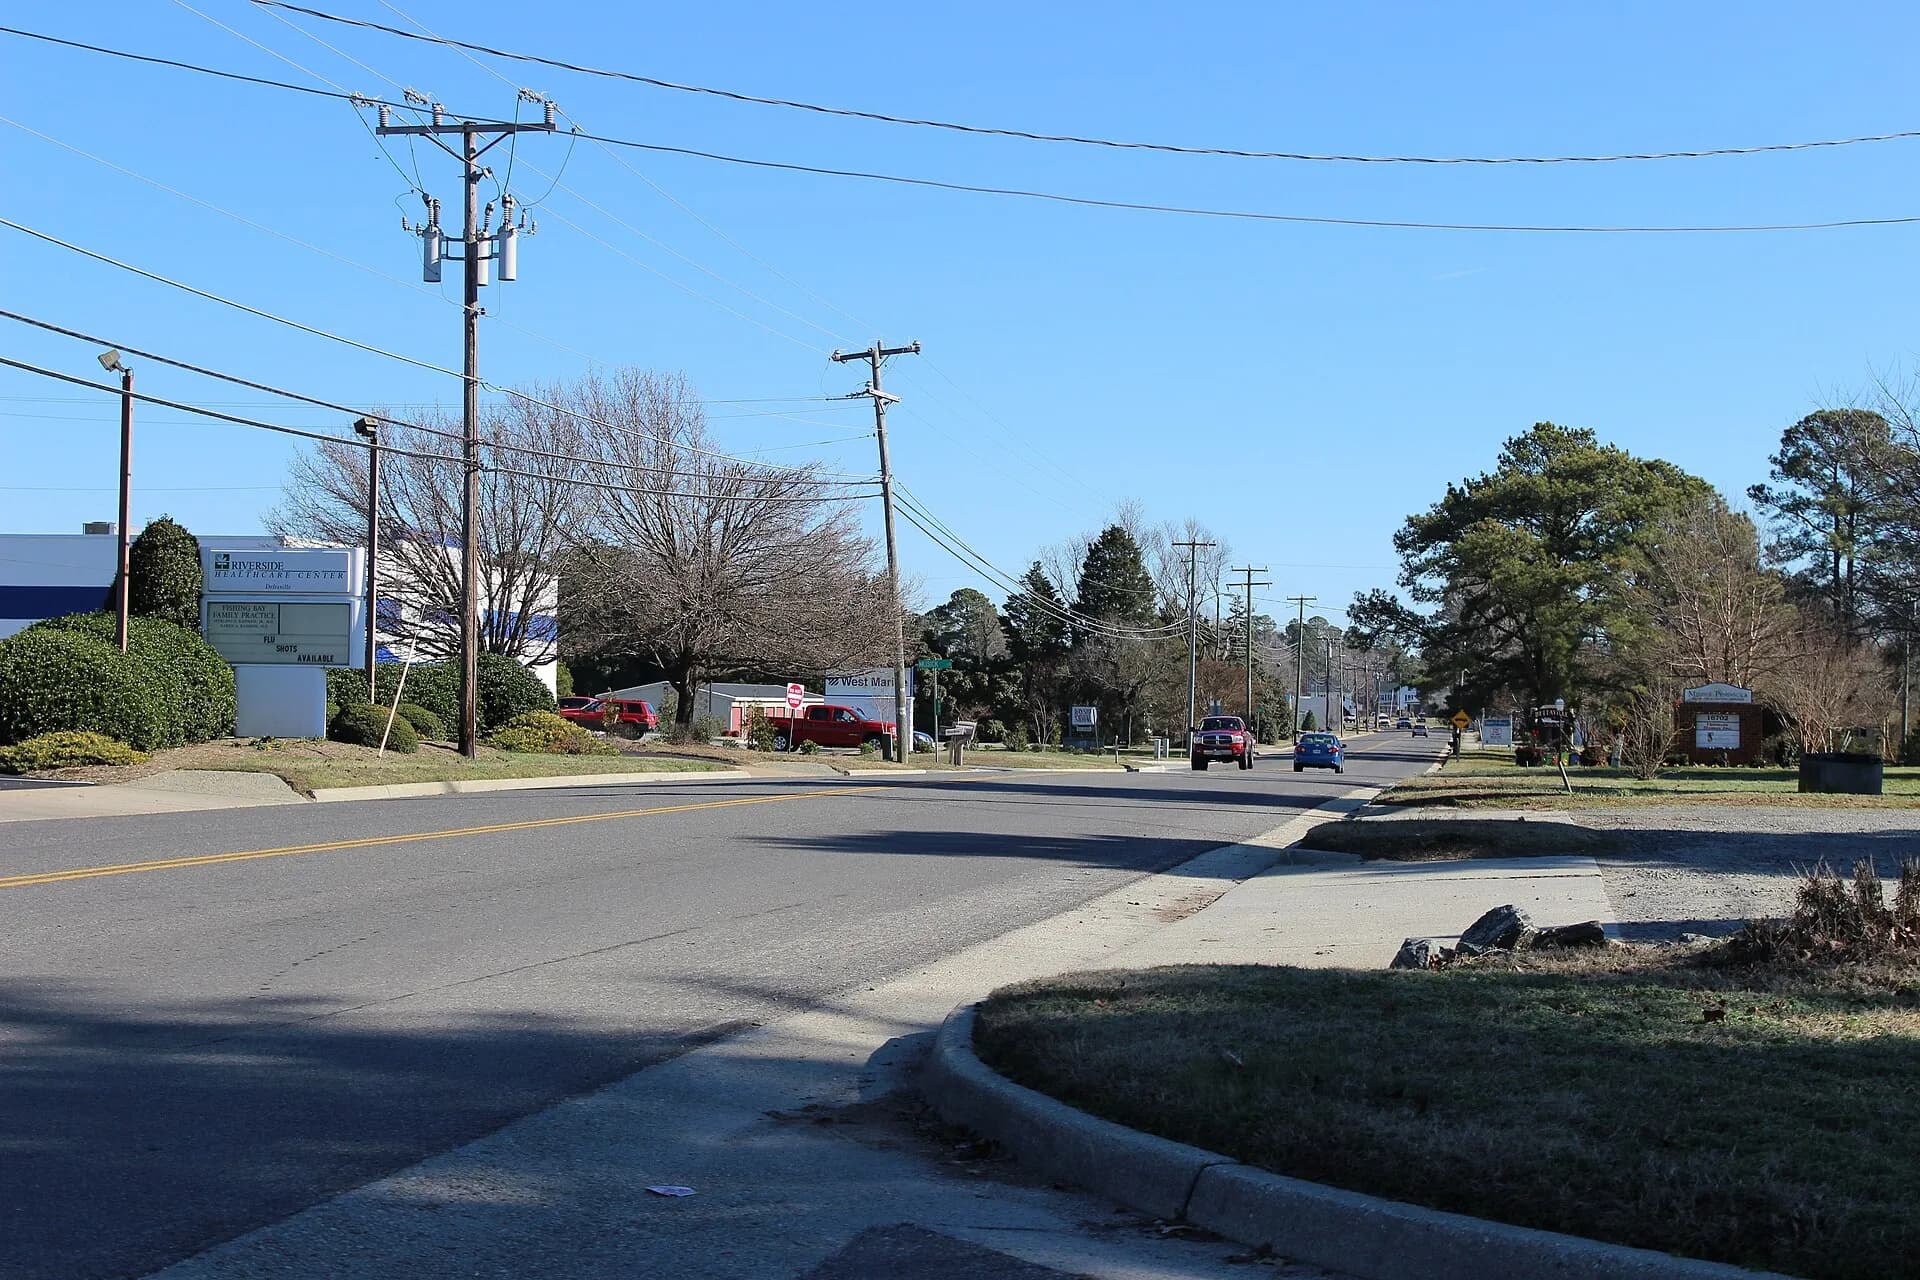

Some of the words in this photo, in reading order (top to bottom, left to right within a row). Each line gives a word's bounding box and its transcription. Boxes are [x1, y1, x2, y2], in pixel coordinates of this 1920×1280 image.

[232, 561, 284, 570] RIVERSIDE
[214, 571, 290, 579] HEALTHCARE
[297, 571, 344, 580] CENTER
[263, 635, 275, 644] FLU
[276, 645, 298, 653] SHOTS
[297, 654, 334, 663] AVAILABLE
[841, 677, 868, 687] West
